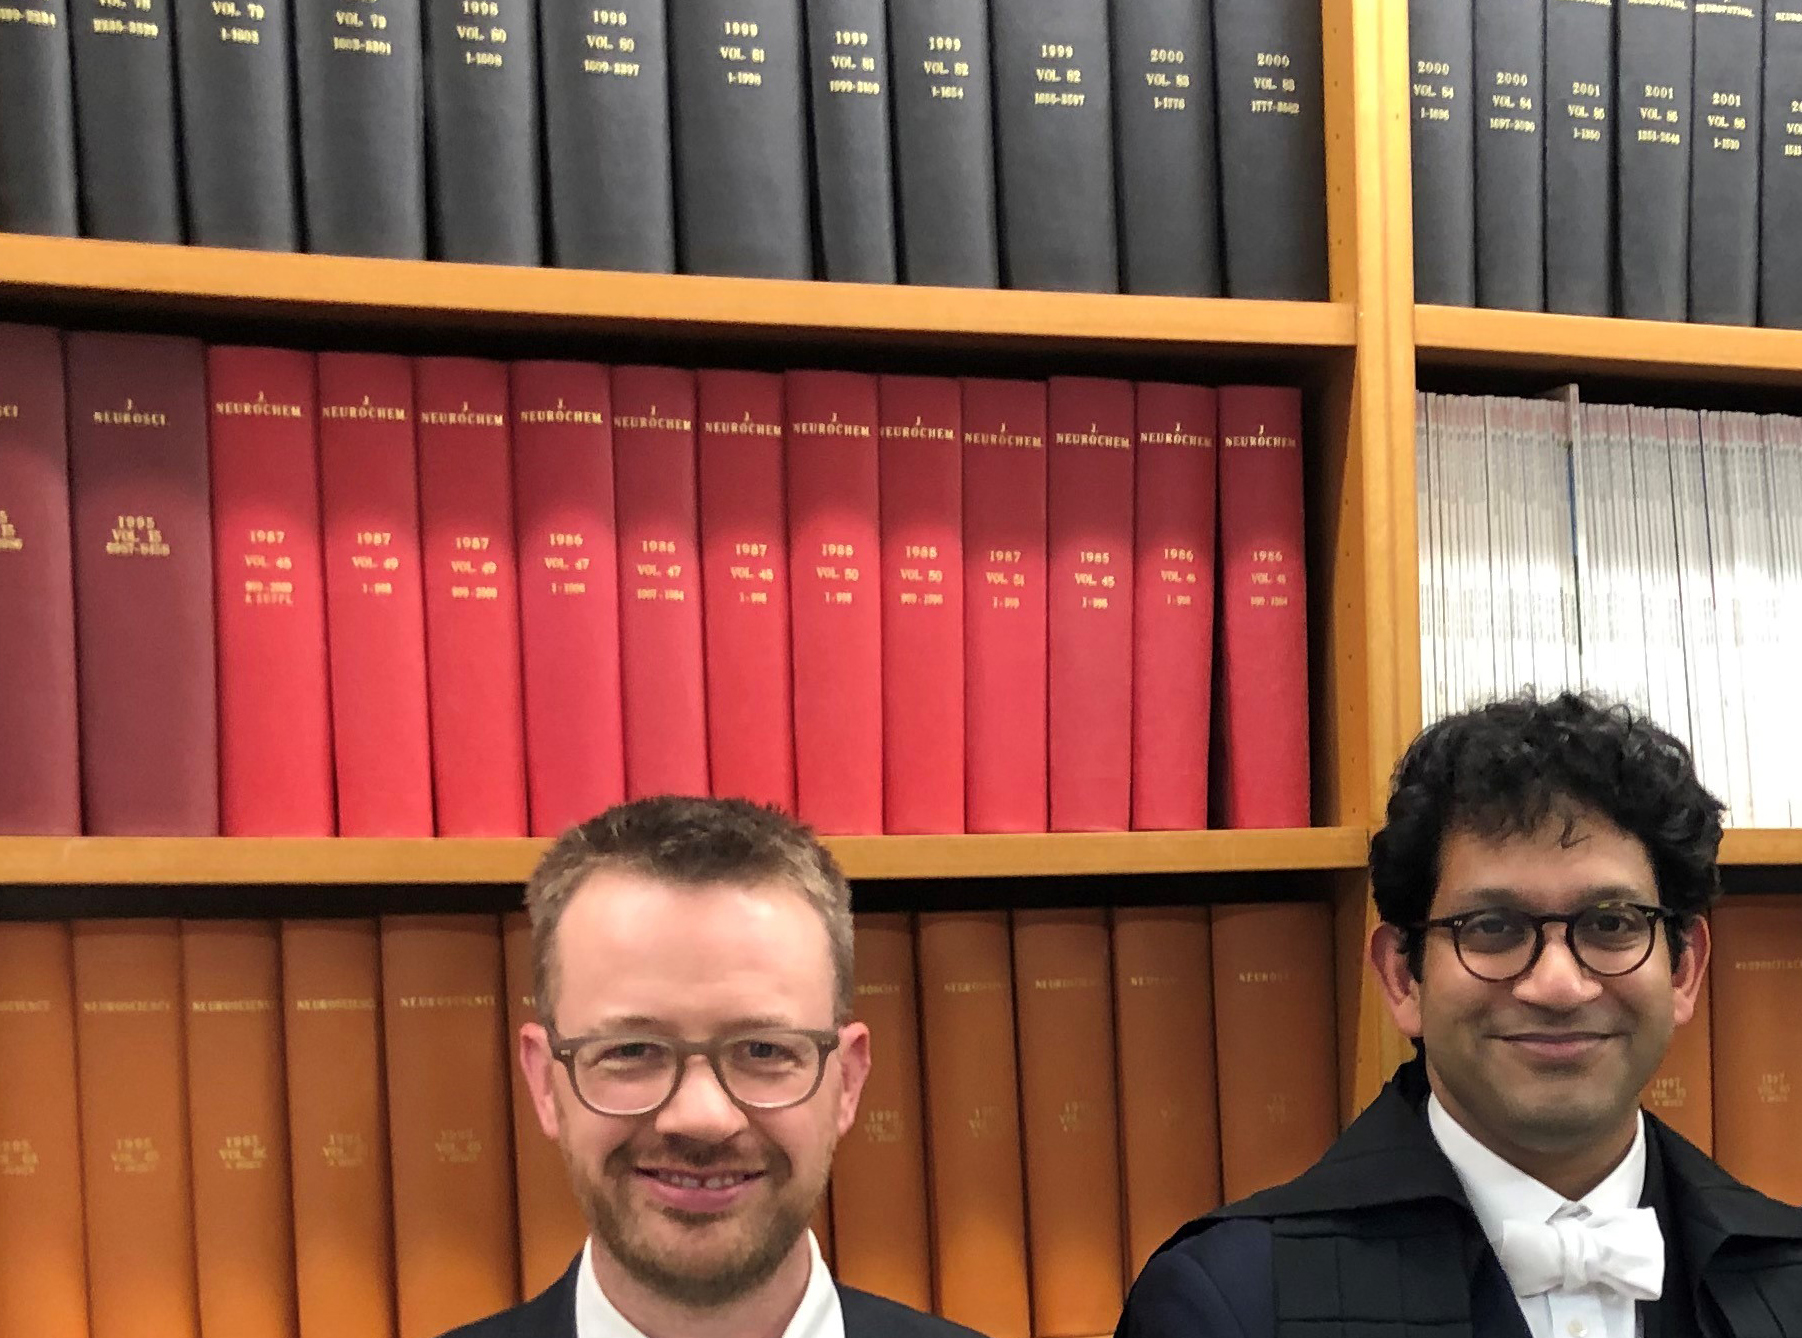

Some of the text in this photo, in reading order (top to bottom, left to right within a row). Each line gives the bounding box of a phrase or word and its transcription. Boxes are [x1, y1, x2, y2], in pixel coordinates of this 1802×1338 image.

[1150, 49, 1184, 64] 2000
[1257, 53, 1290, 67] 2000
[1417, 61, 1449, 75] 2000
[1496, 72, 1528, 87] 2000
[1572, 82, 1601, 98] 2001
[1644, 85, 1674, 100] 2001
[1712, 92, 1741, 107] 2001
[216, 402, 302, 417] NEUROCHEM
[323, 406, 405, 420] NEUROCHEM
[94, 411, 168, 426] NEUROSCI
[421, 412, 503, 426] NEUROCHEM
[521, 410, 603, 424] NEUROCHEM
[614, 416, 691, 431] NEUROCHEM
[705, 421, 782, 437] NEUROCHEM
[794, 422, 870, 437] NEUROCHEM
[964, 433, 1042, 447] NEUROCHEM
[1056, 433, 1131, 448] NEUROCHEM
[250, 530, 285, 543] 1987
[357, 533, 391, 545] 1987
[456, 537, 489, 549] 1987
[550, 533, 583, 546] 1986
[642, 540, 676, 553] 1986
[736, 543, 767, 557] 1987
[822, 543, 854, 557] 1988
[905, 546, 938, 559] 1988
[990, 550, 1021, 563] 1987
[1080, 551, 1110, 564] 1985
[1164, 548, 1194, 562] 1986
[1253, 551, 1283, 562] 1986
